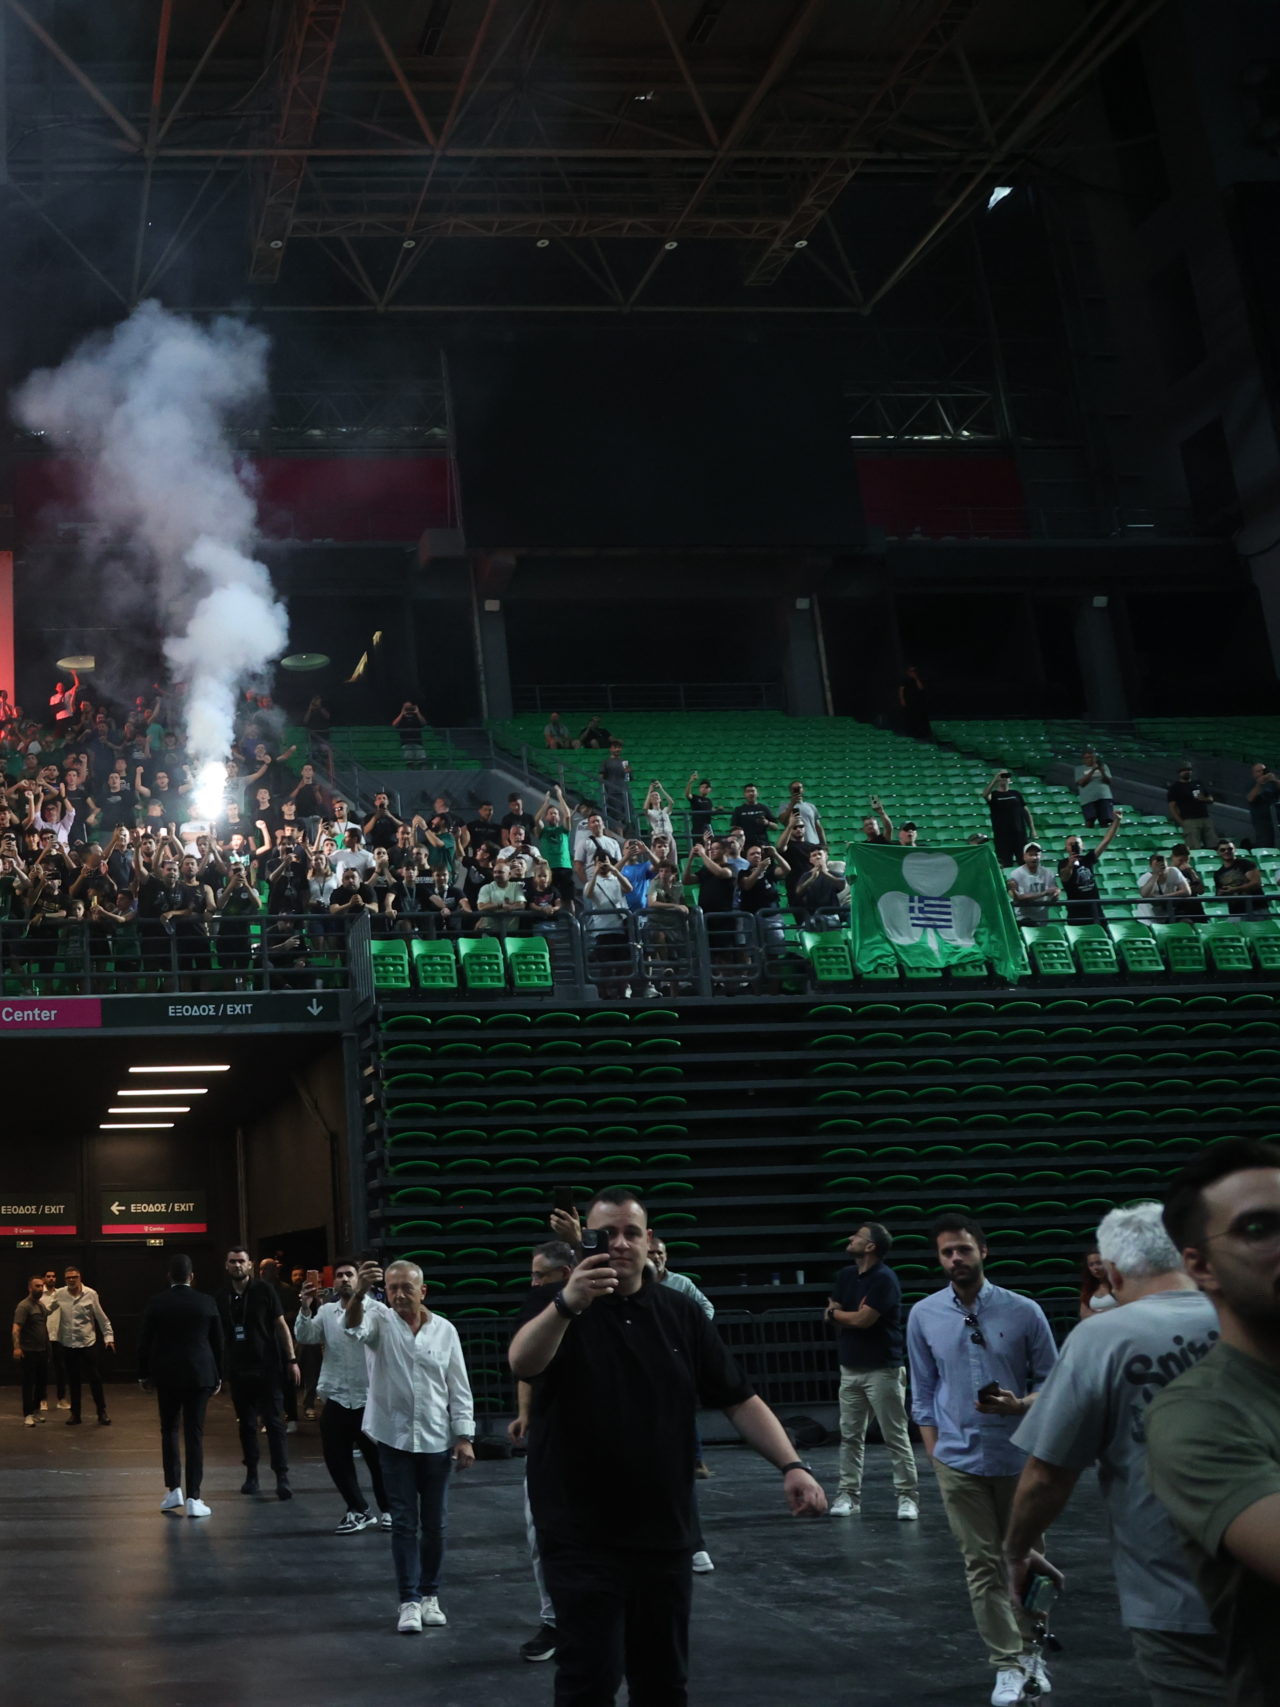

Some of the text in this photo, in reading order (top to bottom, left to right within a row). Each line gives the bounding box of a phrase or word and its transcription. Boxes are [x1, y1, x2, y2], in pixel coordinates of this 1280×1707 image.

[1, 1007, 58, 1022] Center
[168, 1005, 217, 1017] ΕΞΟΔΟΣ
[227, 1003, 253, 1015] EXIT
[1, 1205, 37, 1215] ΕΞΟΔΟΣ
[44, 1205, 65, 1214] EXIT
[130, 1203, 167, 1213] ΕΞΟΔΟΣ
[174, 1202, 195, 1212] EXIT
